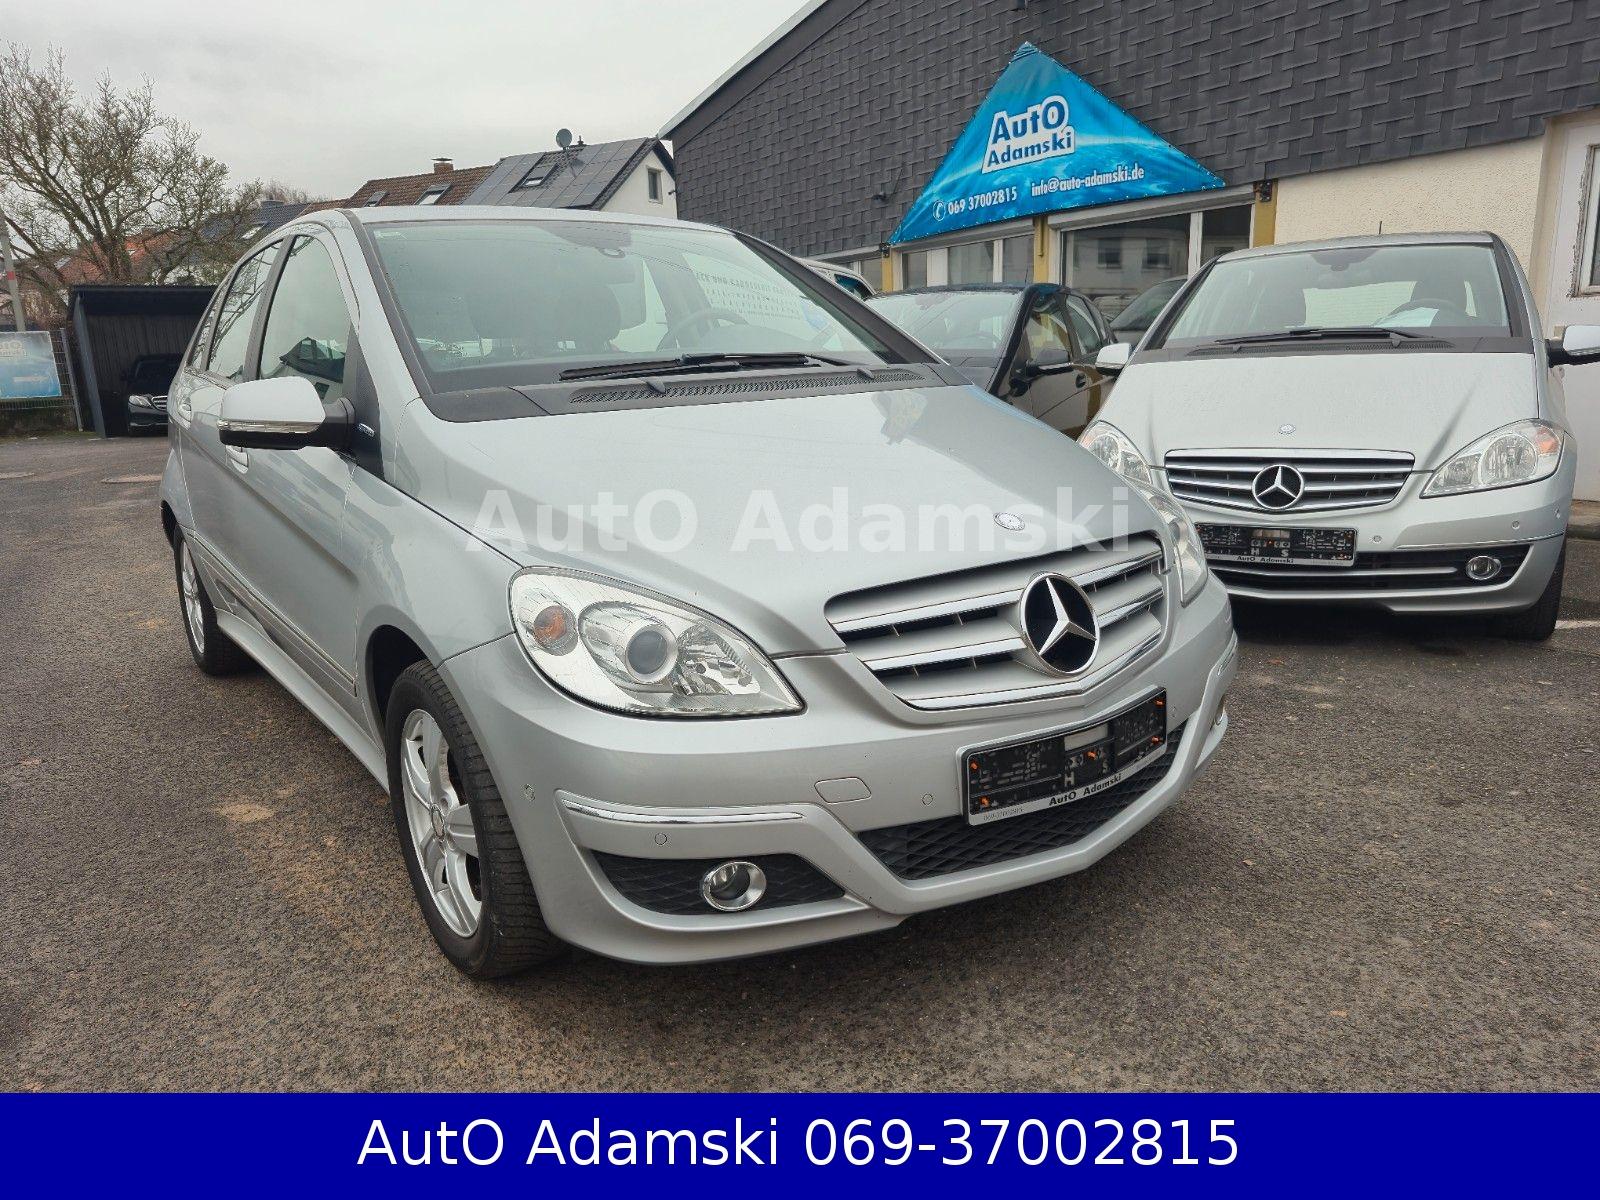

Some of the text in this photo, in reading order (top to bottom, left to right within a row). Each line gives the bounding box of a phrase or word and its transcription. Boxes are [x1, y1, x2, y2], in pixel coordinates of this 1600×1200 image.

[992, 100, 1066, 145] AutO
[987, 131, 1072, 168] Adamski
[947, 163, 1145, 215] 069 37002815 info@auto-adamski.de
[1048, 773, 1122, 807] AutO Adamski
